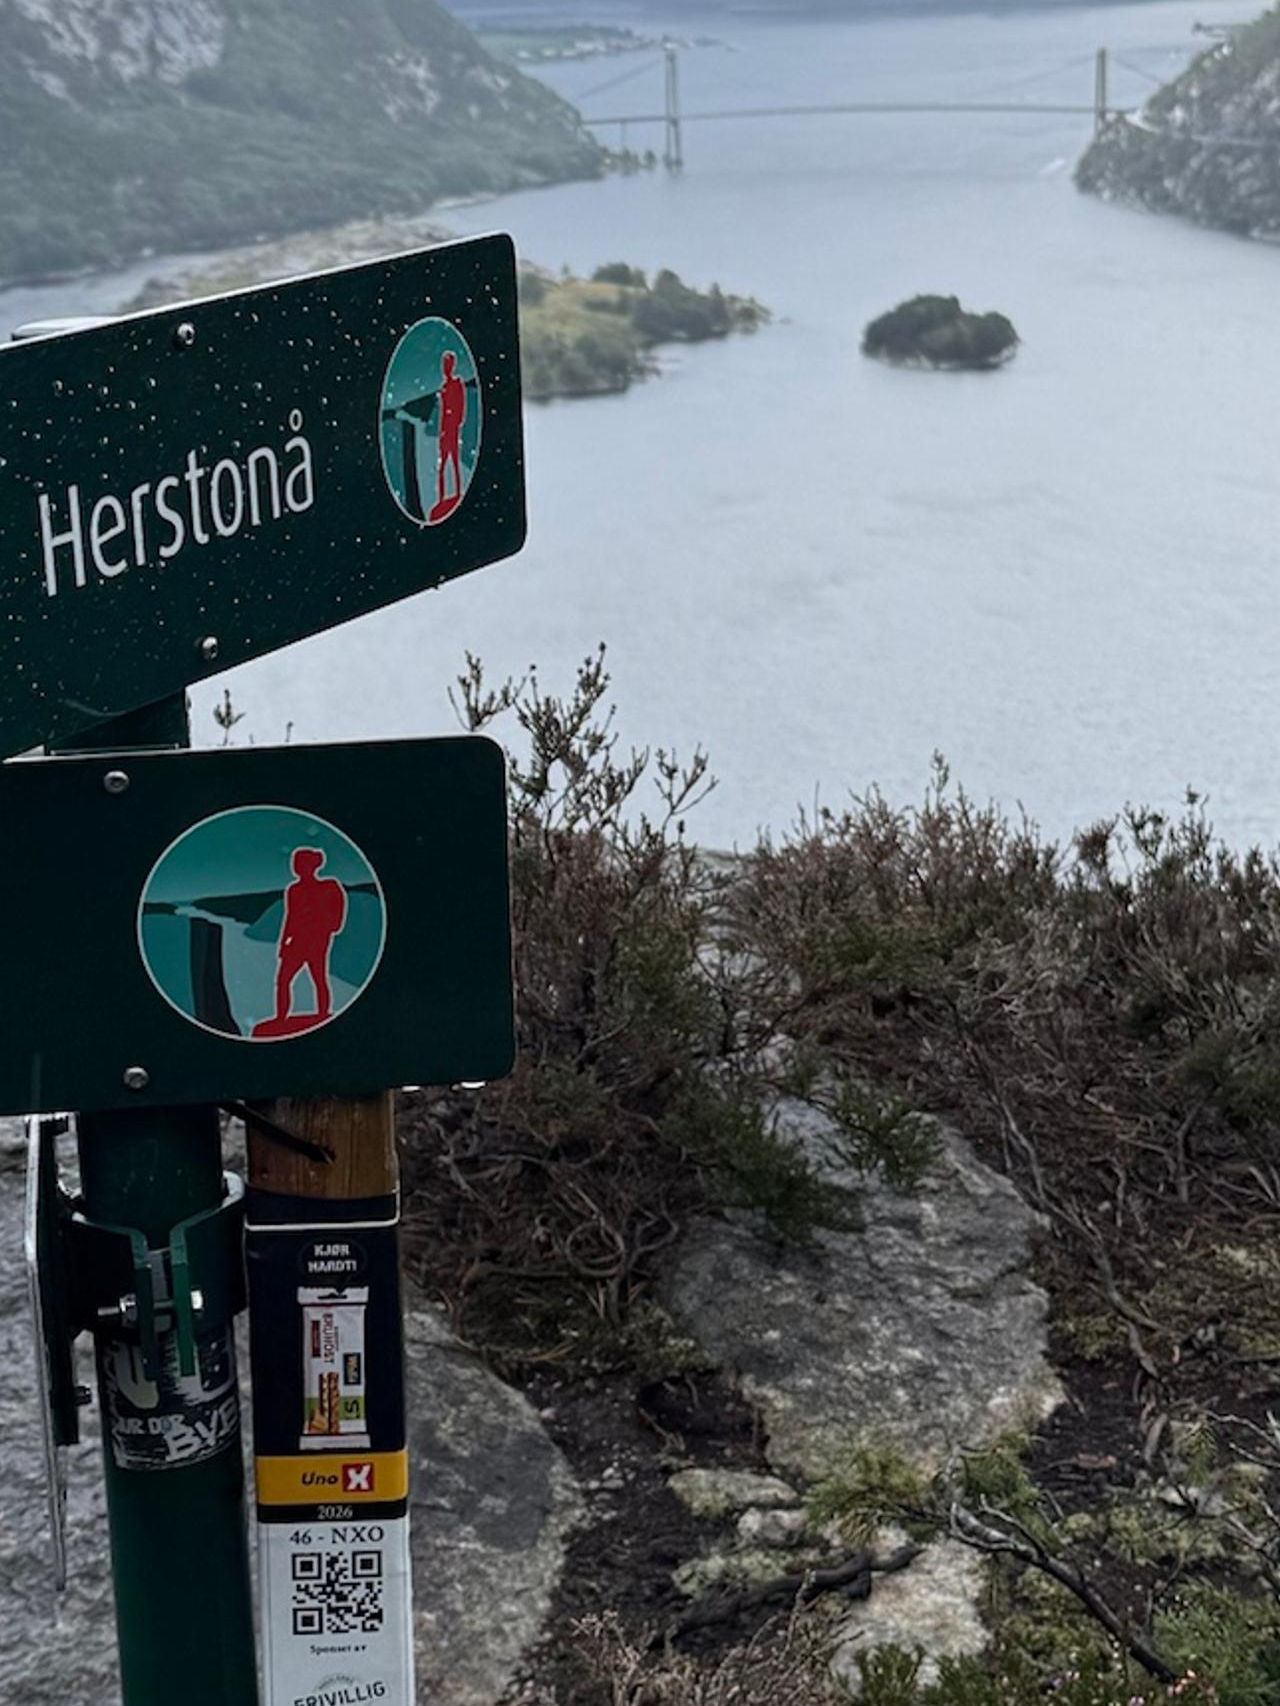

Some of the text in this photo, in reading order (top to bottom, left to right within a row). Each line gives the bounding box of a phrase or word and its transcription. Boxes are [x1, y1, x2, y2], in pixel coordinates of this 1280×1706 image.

[38, 409, 315, 597] Herstonå
[301, 1464, 371, 1491] Uno X
[317, 1505, 354, 1520] 2026
[289, 1528, 312, 1545] 46
[331, 1525, 385, 1544] NXO
